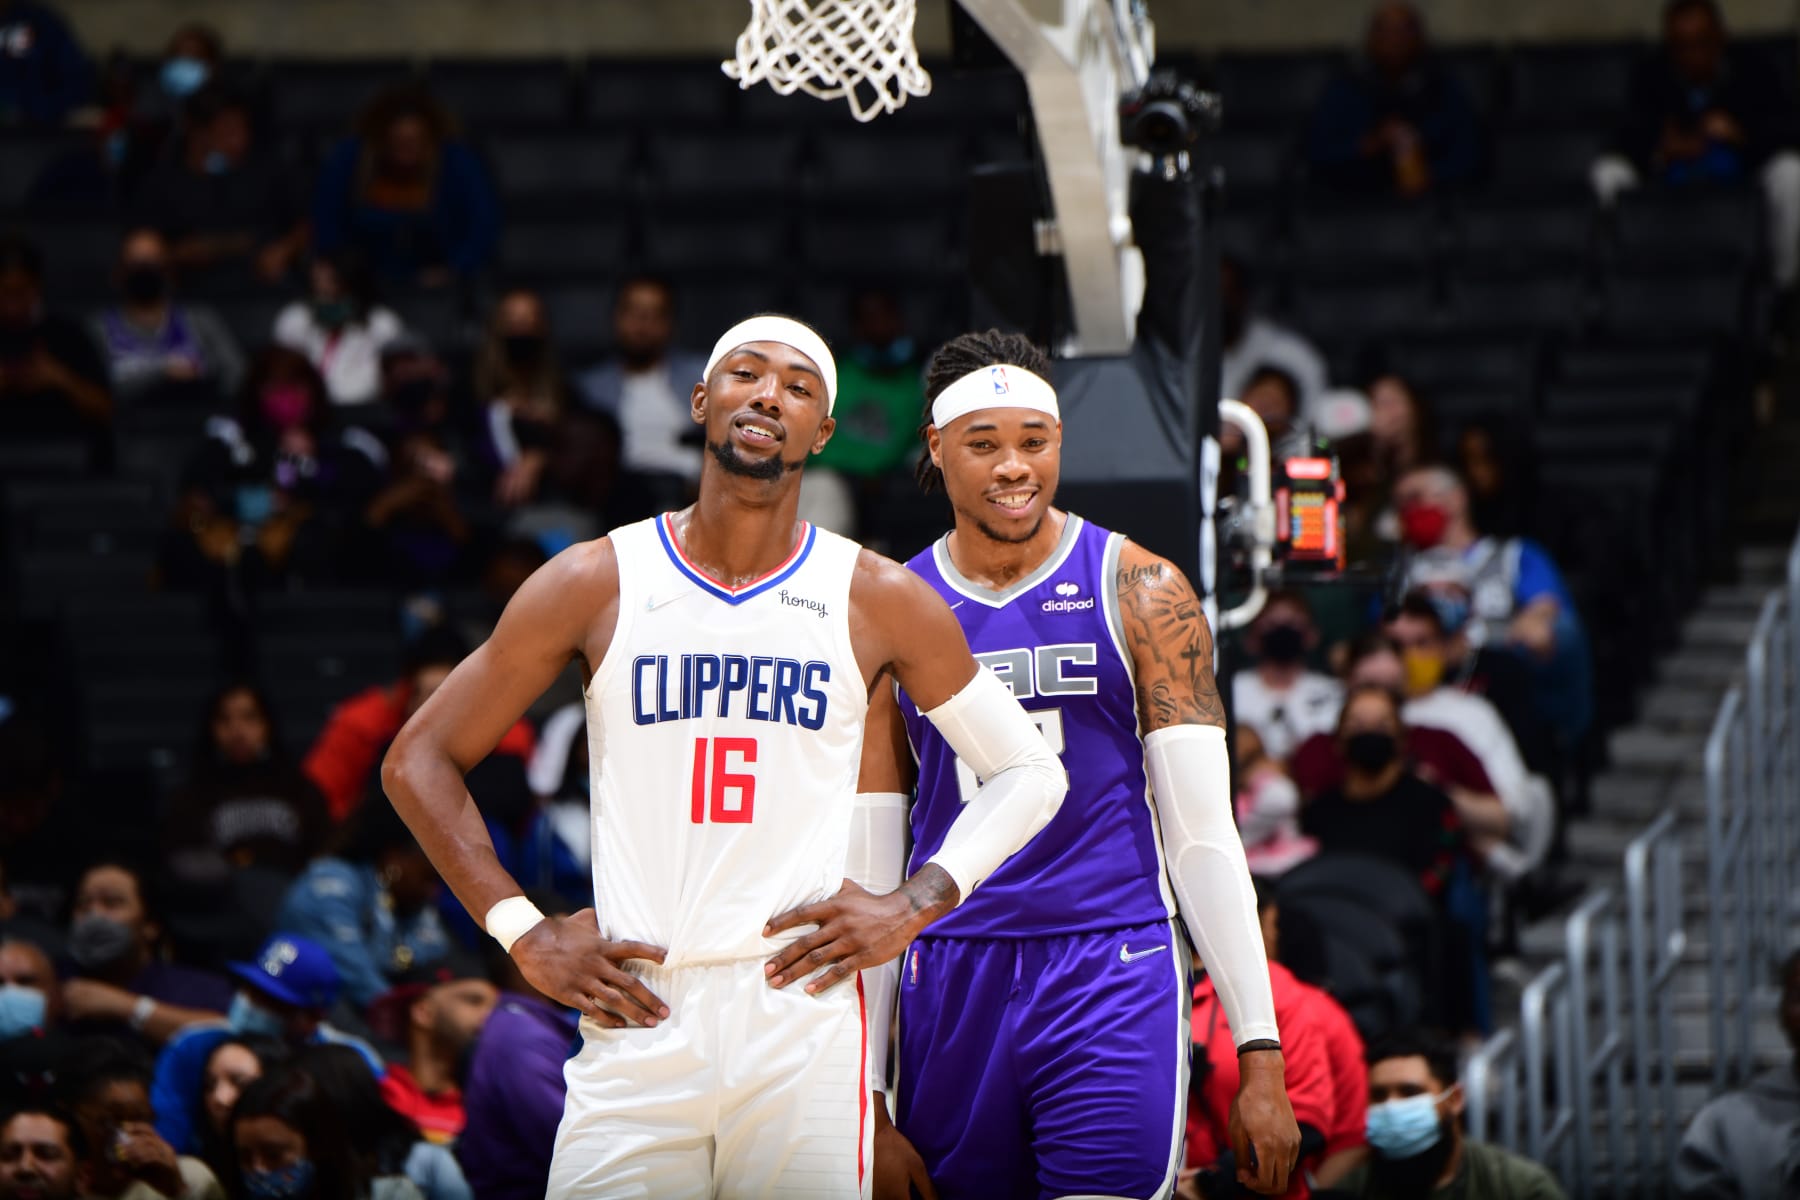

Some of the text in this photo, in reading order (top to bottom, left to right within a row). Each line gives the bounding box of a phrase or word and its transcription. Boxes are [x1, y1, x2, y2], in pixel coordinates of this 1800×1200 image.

[777, 589, 829, 619] honey
[1041, 597, 1094, 613] dialpad
[631, 654, 831, 731] CLIPPERS
[971, 642, 1098, 701] AC
[691, 736, 758, 824] 16
